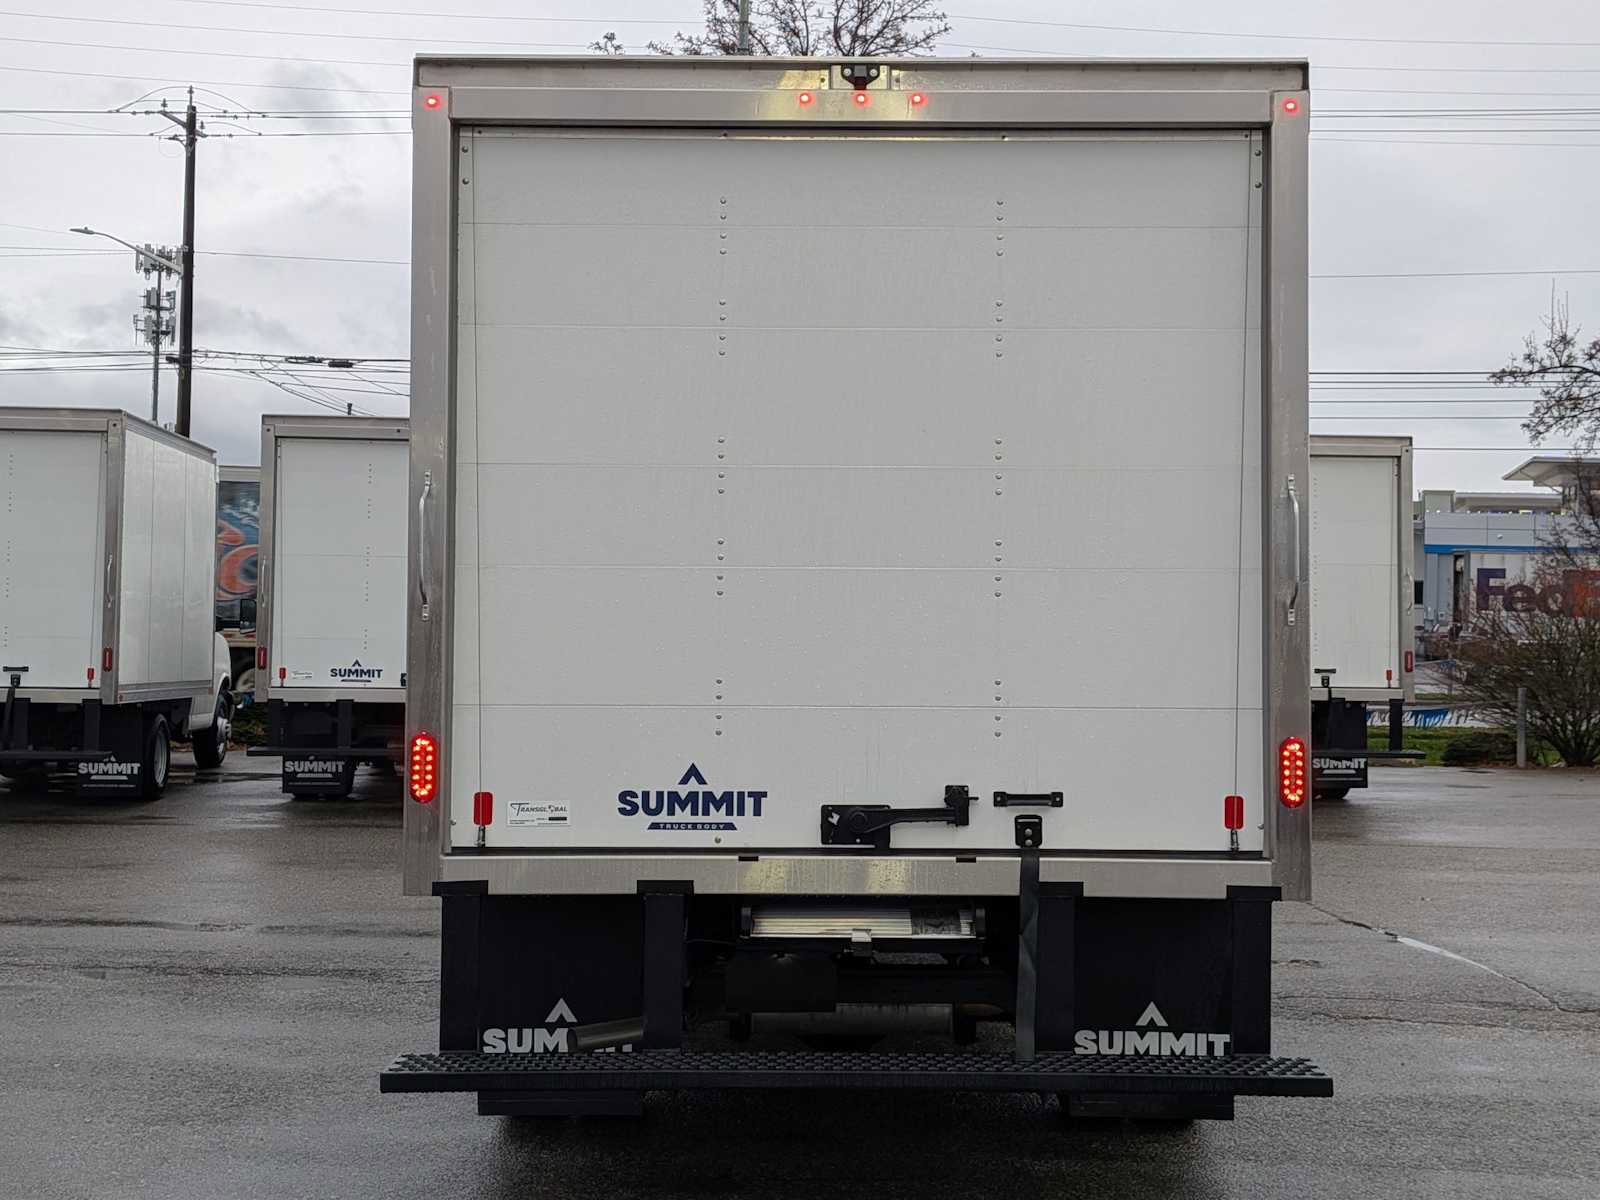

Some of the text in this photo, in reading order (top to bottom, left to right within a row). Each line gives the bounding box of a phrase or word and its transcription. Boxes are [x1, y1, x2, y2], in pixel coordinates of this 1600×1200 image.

[330, 668, 383, 678] SUMMIT
[78, 762, 141, 775] SUMMIT
[285, 760, 345, 773] SUMMIT
[1312, 758, 1367, 769] SUMMIT
[617, 790, 768, 816] SUMMIT
[482, 1027, 633, 1054] SUM
[1074, 1029, 1231, 1057] SUMMIT
